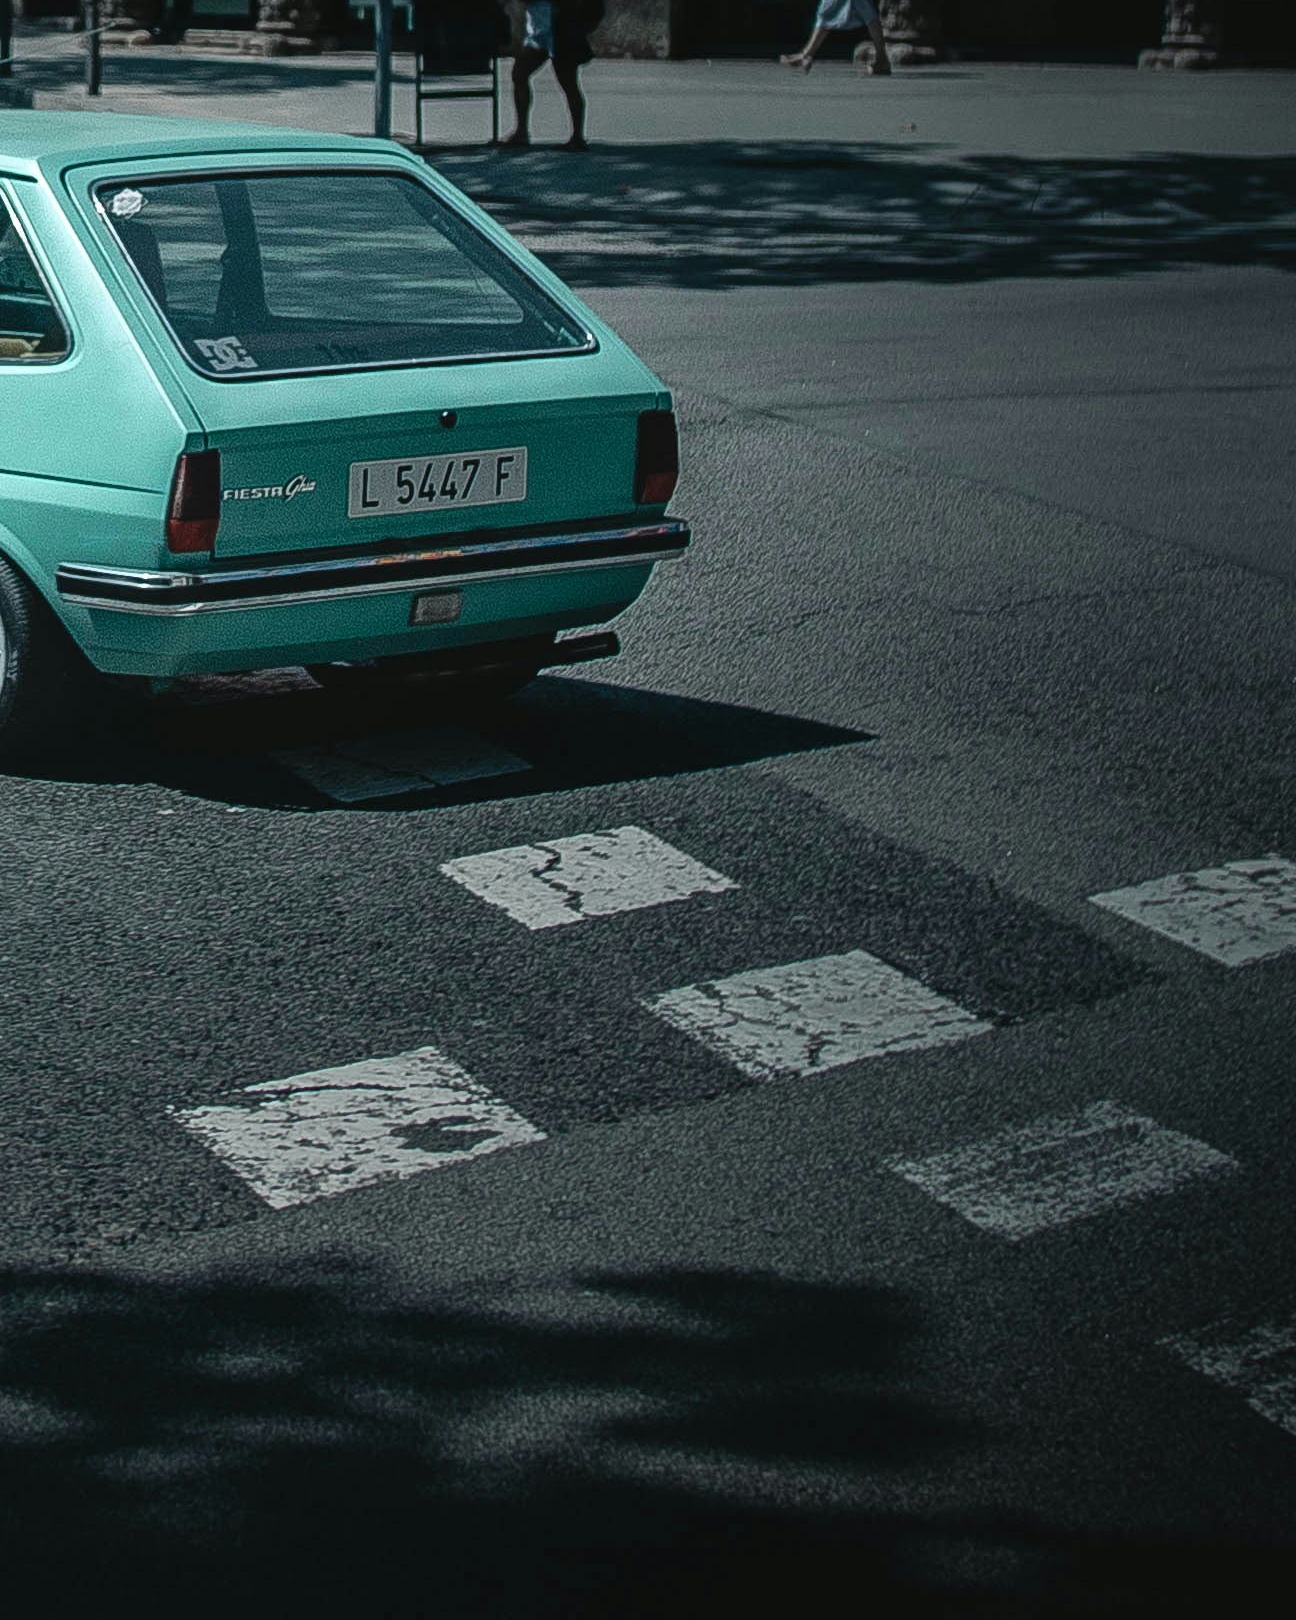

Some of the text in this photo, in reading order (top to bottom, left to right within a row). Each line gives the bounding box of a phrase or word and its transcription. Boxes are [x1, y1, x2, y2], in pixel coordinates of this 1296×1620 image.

[222, 474, 317, 503] FIESTA Ghia
[361, 456, 515, 508] L 5447 F
